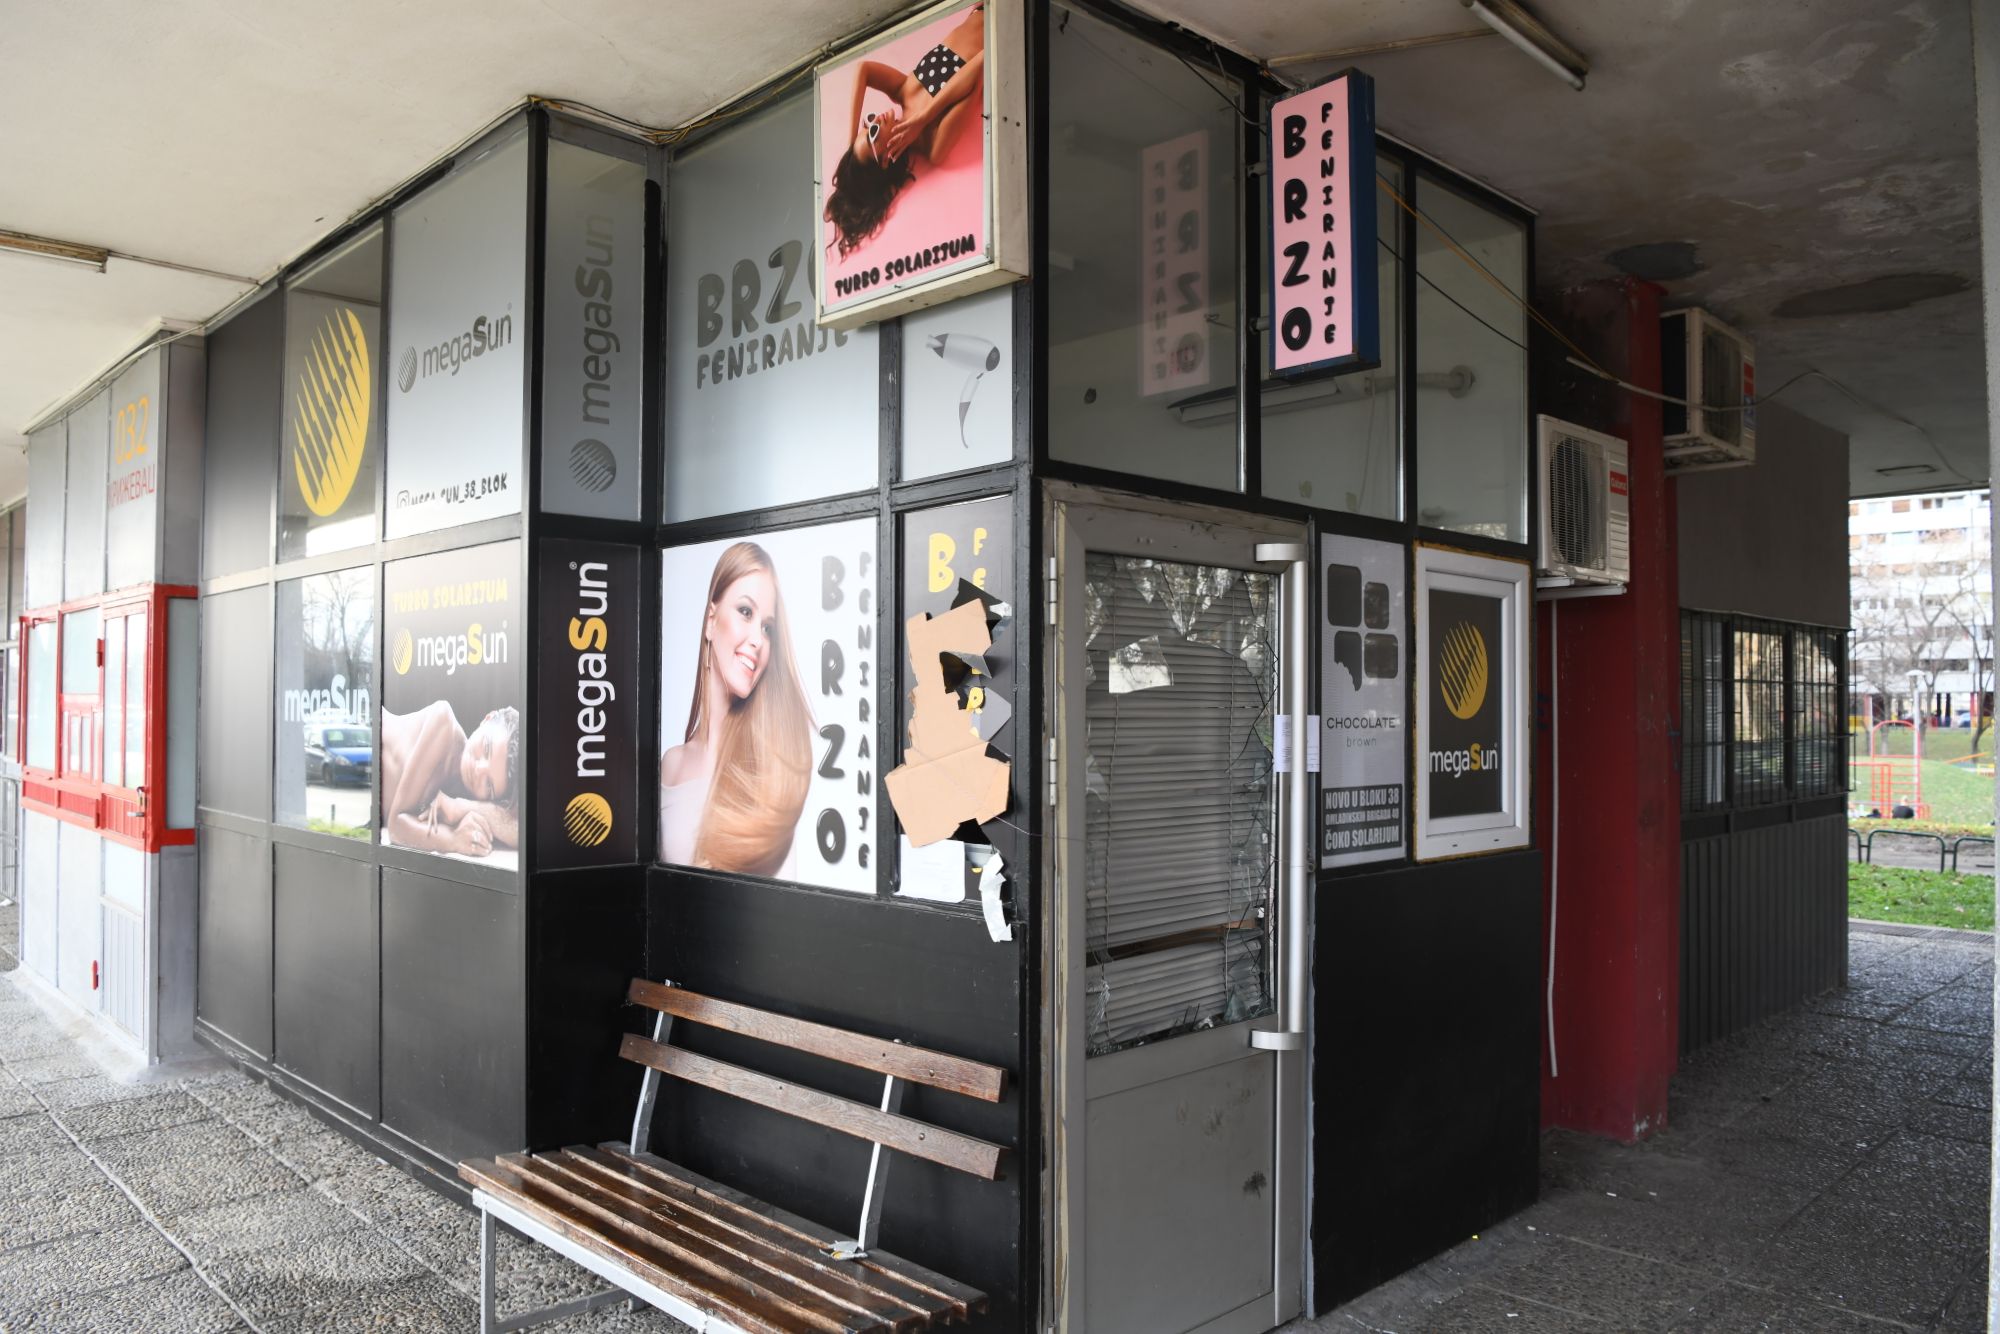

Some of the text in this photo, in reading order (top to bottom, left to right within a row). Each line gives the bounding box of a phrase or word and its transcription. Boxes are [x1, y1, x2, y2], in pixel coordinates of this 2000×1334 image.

[1281, 114, 1312, 351] BRZO
[1320, 102, 1336, 344] FENIRANJE
[835, 234, 976, 297] TURBO SOLARIJUM
[115, 394, 149, 465] 032
[411, 472, 507, 506] MEGASUN_38_BLOK
[392, 578, 508, 614] TURBO SOLARIJUM
[417, 623, 507, 676] megaSun
[816, 555, 846, 865] BRZO
[857, 551, 872, 869] FENIRANJE
[1326, 717, 1396, 729] CHOCOLATE
[1346, 736, 1377, 748] brown
[1429, 743, 1498, 778] megaSun
[1325, 788, 1399, 809] NOVO U BLOKU 38
[1325, 825, 1399, 850] ČOKO SOLARIJUM
